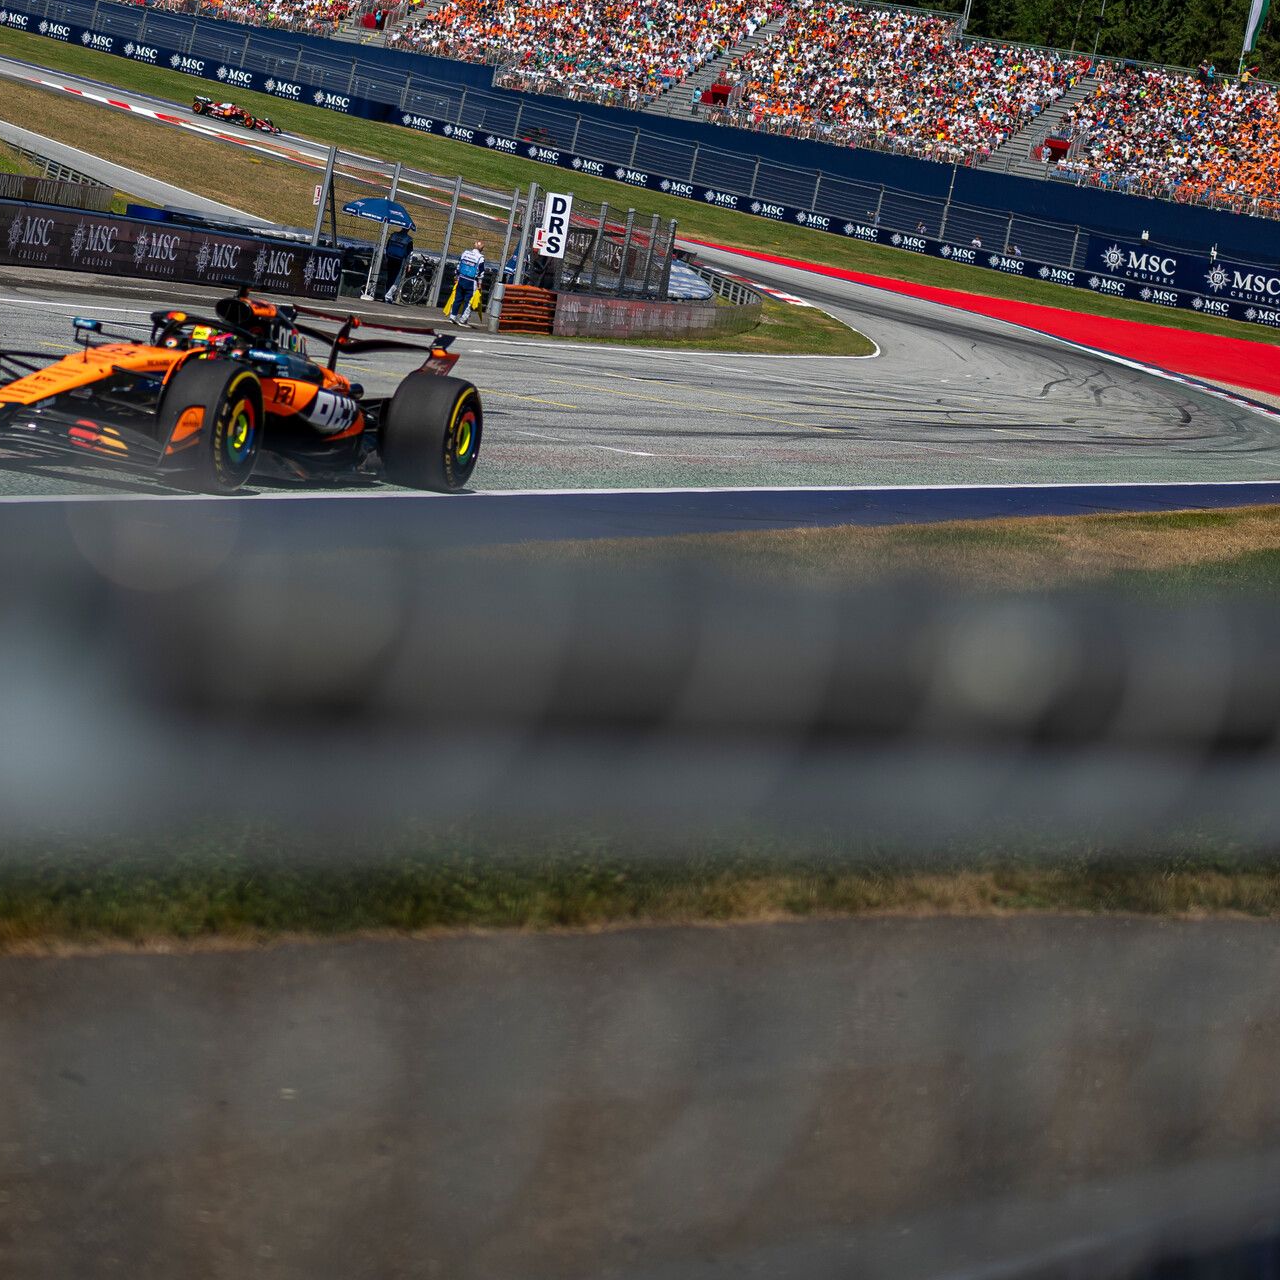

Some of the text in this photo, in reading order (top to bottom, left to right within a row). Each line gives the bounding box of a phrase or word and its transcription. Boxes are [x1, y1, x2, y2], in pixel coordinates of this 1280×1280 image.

[8, 13, 28, 25] MSC
[49, 23, 70, 36] MSC
[92, 34, 112, 47] MSC
[136, 45, 157, 58] MSC
[181, 57, 204, 70] MSC
[228, 69, 252, 83] MSC
[276, 82, 301, 95] MSC
[325, 94, 349, 107] MSC
[412, 117, 432, 128] MSC
[454, 127, 473, 138] MSC
[496, 138, 517, 149] MSC
[539, 149, 559, 160] MSC
[583, 160, 603, 171] MSC
[626, 171, 647, 182] MSC
[672, 182, 693, 194] MSC
[716, 193, 737, 204] MSC
[762, 204, 784, 215] MSC
[546, 196, 566, 254] DRS
[808, 214, 829, 226] MSC
[22, 216, 54, 246] MSC
[856, 226, 878, 237] MSC
[85, 224, 118, 253] MSC
[903, 236, 925, 248] MSC
[148, 233, 181, 260] MSC
[18, 250, 47, 261] CRUISES
[210, 243, 240, 269] MSC
[952, 248, 975, 259] MSC
[82, 257, 112, 267] CRUISES
[267, 250, 294, 276] MSC
[1001, 258, 1024, 270] MSC
[1128, 251, 1176, 275] MSC
[146, 264, 174, 274] CRUISES
[315, 256, 341, 281] MSC
[1051, 269, 1075, 280] MSC
[1126, 270, 1175, 285] CRUISES
[264, 279, 289, 289] CRUISES
[313, 284, 337, 293] CRUISES
[1101, 279, 1125, 291] MSC
[1153, 290, 1177, 302] MSC
[1230, 290, 1280, 305] CRUISES
[1205, 300, 1229, 312] MSC
